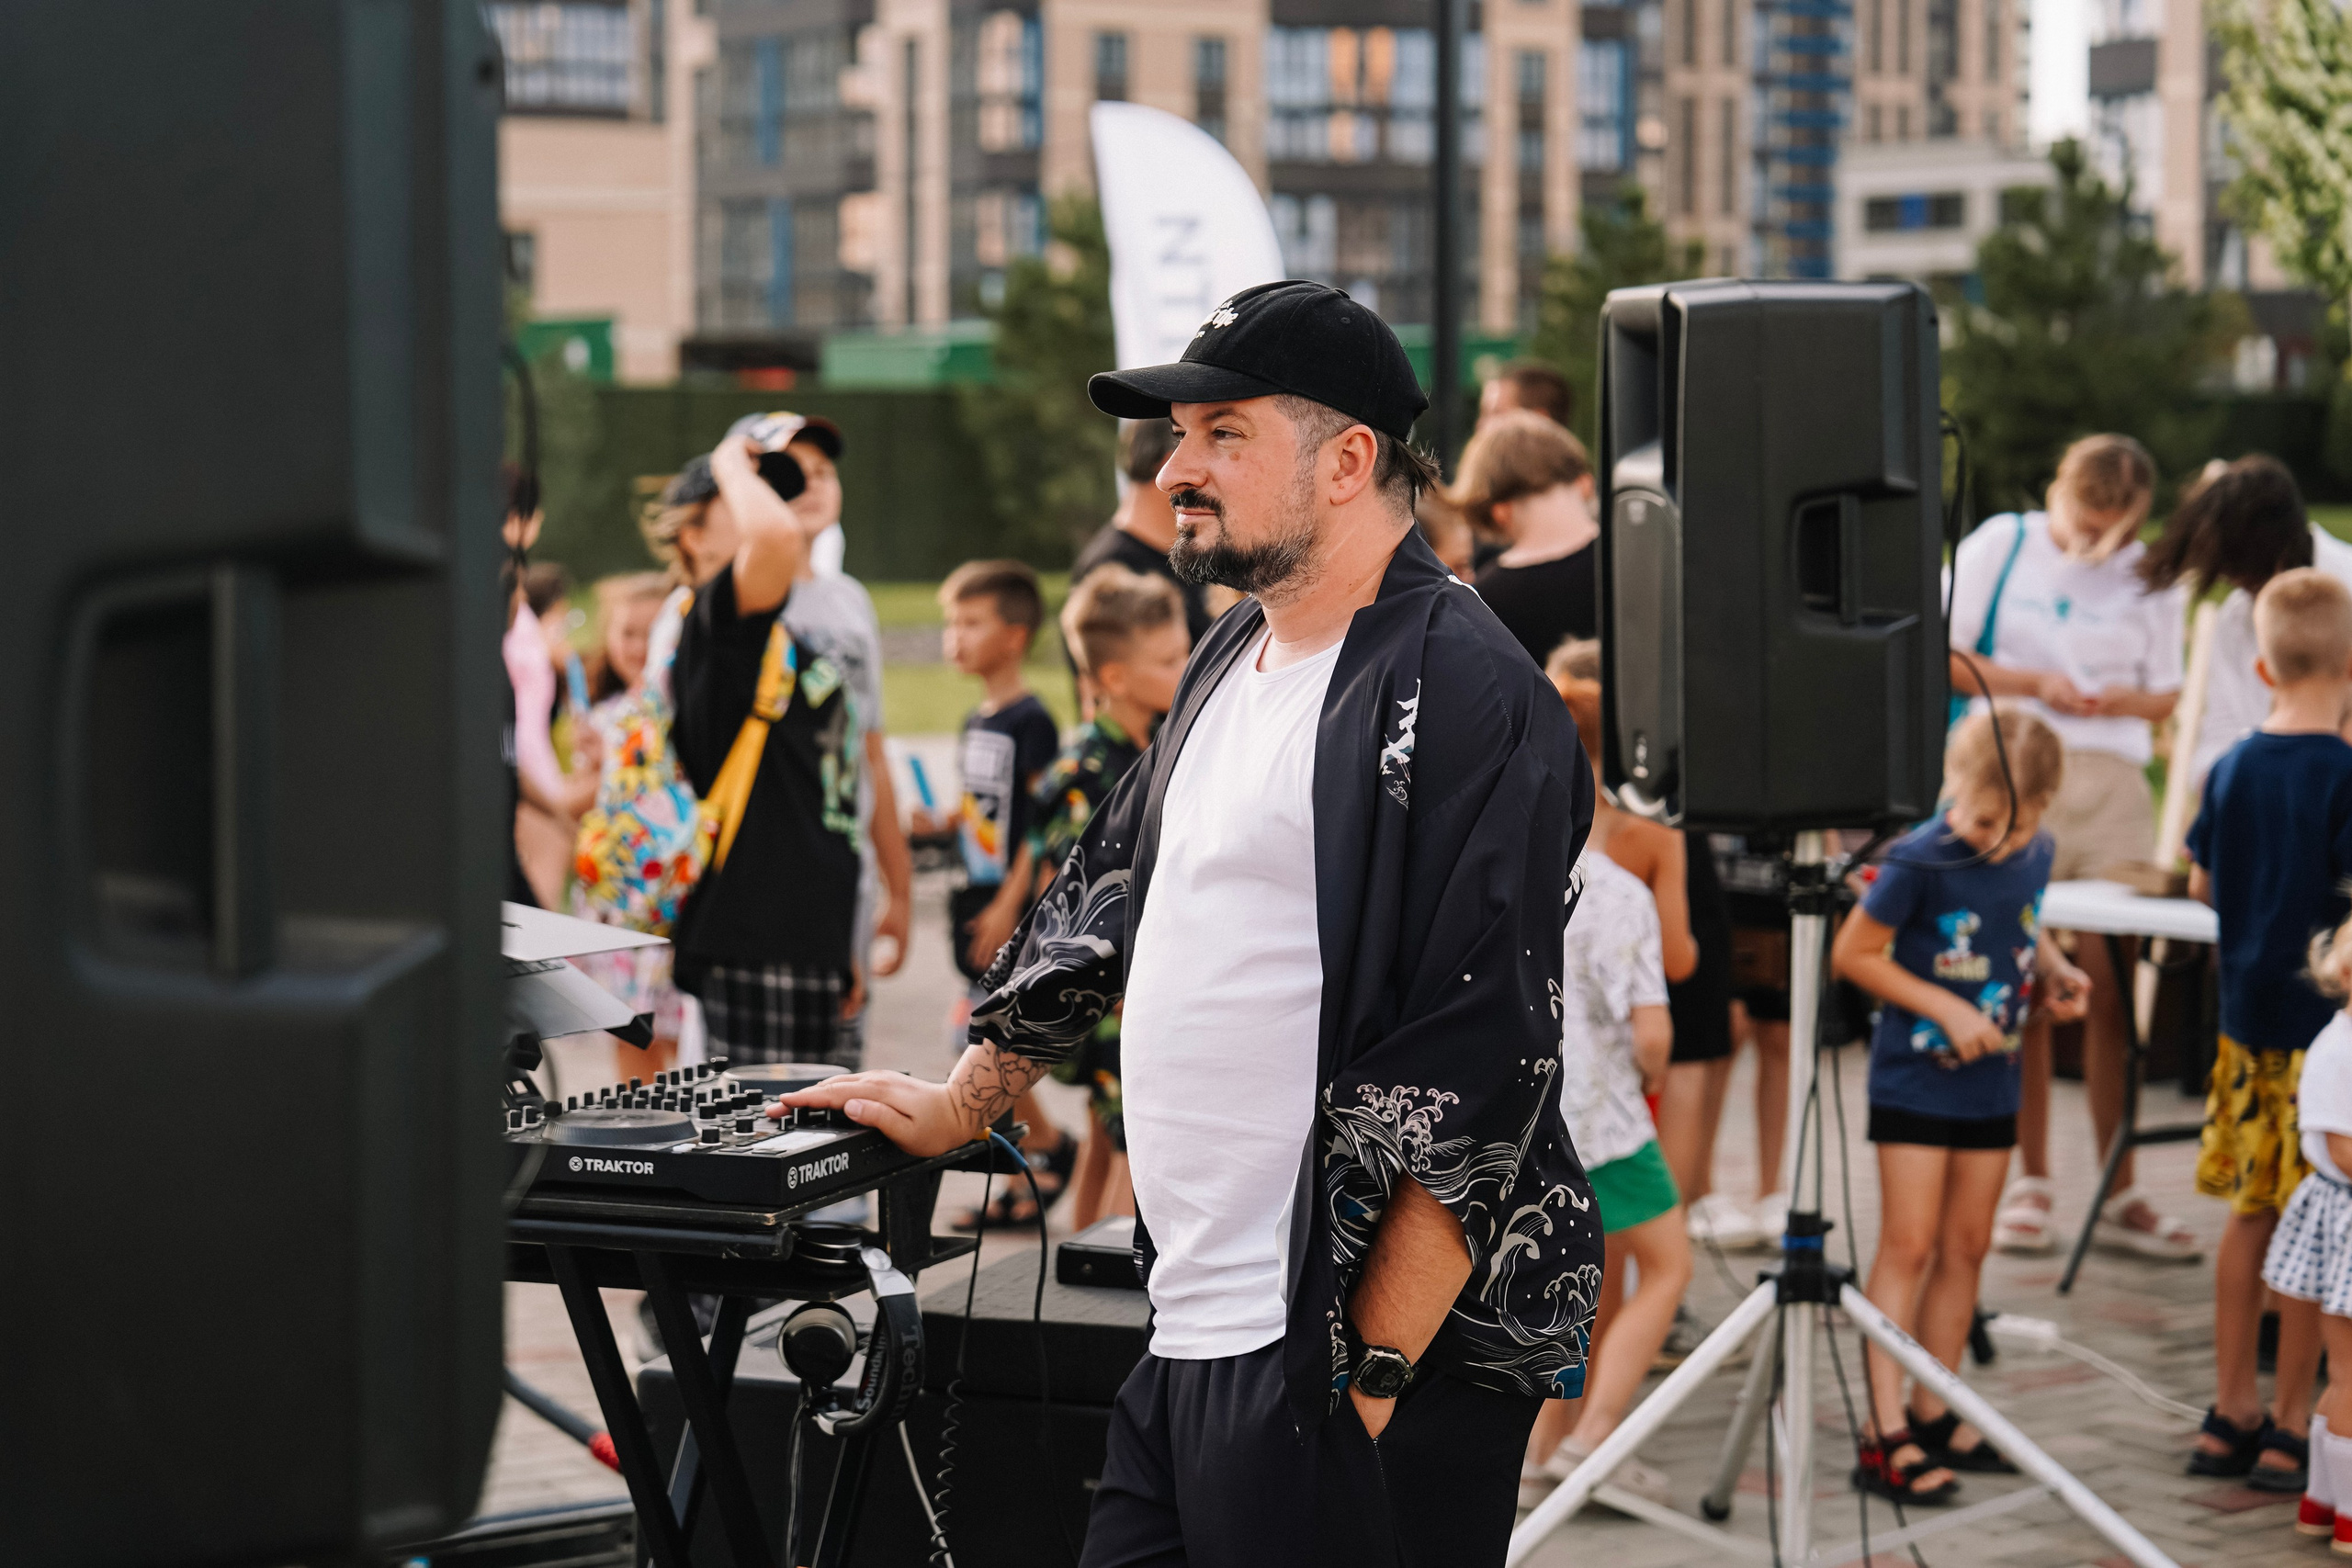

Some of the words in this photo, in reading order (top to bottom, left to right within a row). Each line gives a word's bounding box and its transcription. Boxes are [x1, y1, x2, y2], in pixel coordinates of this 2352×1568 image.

[583, 1157, 654, 1175] TRAKTOR
[797, 1152, 850, 1184] TRAKTOR
[854, 1329, 888, 1411] Soundkin
[888, 1325, 922, 1420] Techn
